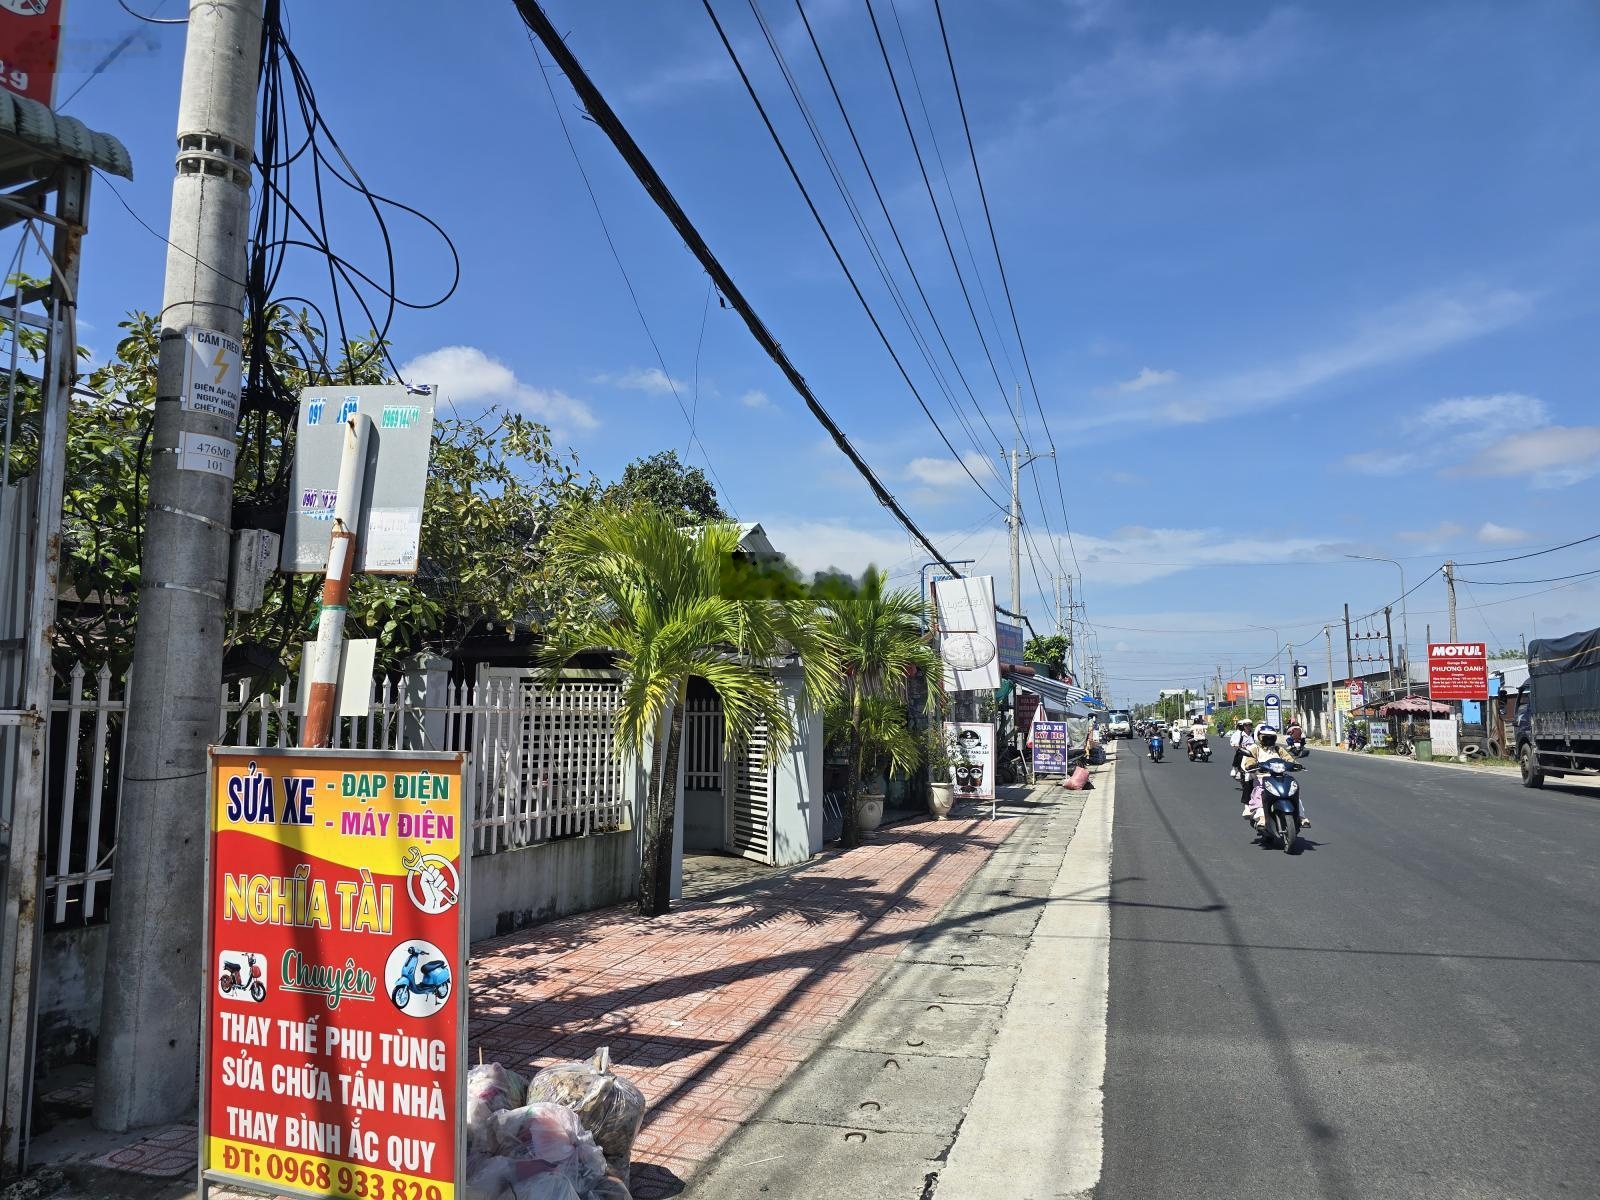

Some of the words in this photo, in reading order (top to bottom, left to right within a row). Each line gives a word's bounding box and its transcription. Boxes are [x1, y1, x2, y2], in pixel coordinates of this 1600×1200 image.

[197, 331, 219, 347] CẤM
[194, 382, 215, 392] ĐIỆN
[216, 386, 227, 395] ÁP
[196, 393, 219, 404] NGUY
[194, 402, 217, 412] CHẾT
[197, 443, 231, 457] 476MP
[208, 459, 223, 471] 101
[1431, 645, 1482, 656] MOTUL
[227, 761, 275, 824] SỬA
[282, 776, 315, 826] XE
[341, 773, 387, 802] ĐẠP
[394, 769, 450, 804] ĐIỆN
[341, 808, 390, 837] MÁY
[397, 810, 454, 844] ĐIỆN
[223, 864, 332, 930] NGHĨA
[335, 869, 394, 935] TÀI
[280, 948, 377, 1010] Chuyên
[220, 1011, 271, 1047] THAY
[277, 1015, 320, 1054] THẾ
[325, 1026, 372, 1068] PHỤ
[379, 1029, 446, 1072] TÙNG
[222, 1049, 265, 1092] SỬA
[271, 1062, 332, 1102] CHỮA
[339, 1070, 385, 1114] TẬN
[392, 1080, 446, 1121] NHÀ
[227, 1106, 278, 1144] THAY
[285, 1113, 341, 1155] BÌNH
[348, 1117, 379, 1163] ẮC
[387, 1135, 436, 1174] QUY
[223, 1145, 260, 1176] ĐT:
[267, 1153, 330, 1190] 0968
[338, 1166, 385, 1200] 933
[392, 1178, 442, 1200] 829
